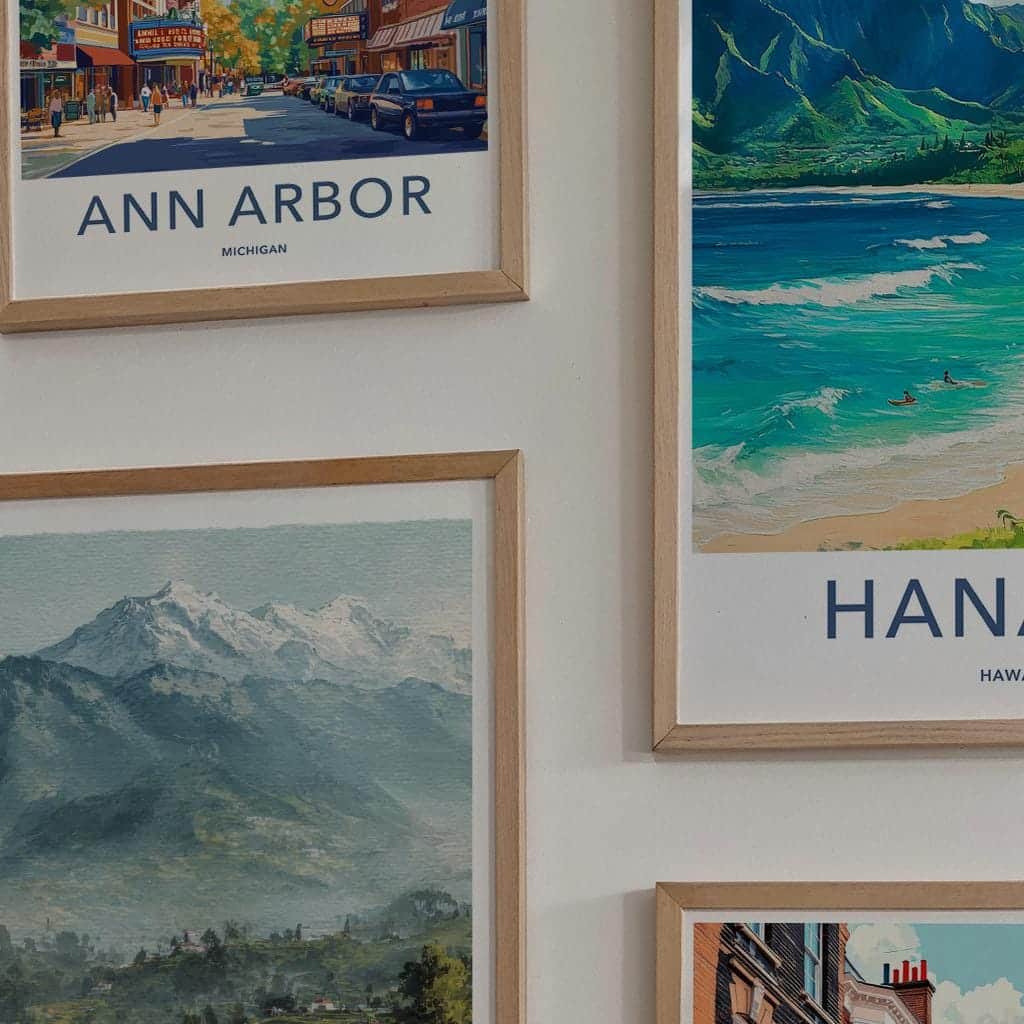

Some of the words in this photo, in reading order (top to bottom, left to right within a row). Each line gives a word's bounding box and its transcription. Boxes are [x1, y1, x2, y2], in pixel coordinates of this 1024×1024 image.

[76, 187, 205, 237] ANN
[228, 175, 433, 227] ARBOR
[221, 243, 288, 257] MICHIGAN
[826, 576, 1024, 640] HAN
[980, 668, 1024, 683] HAW
